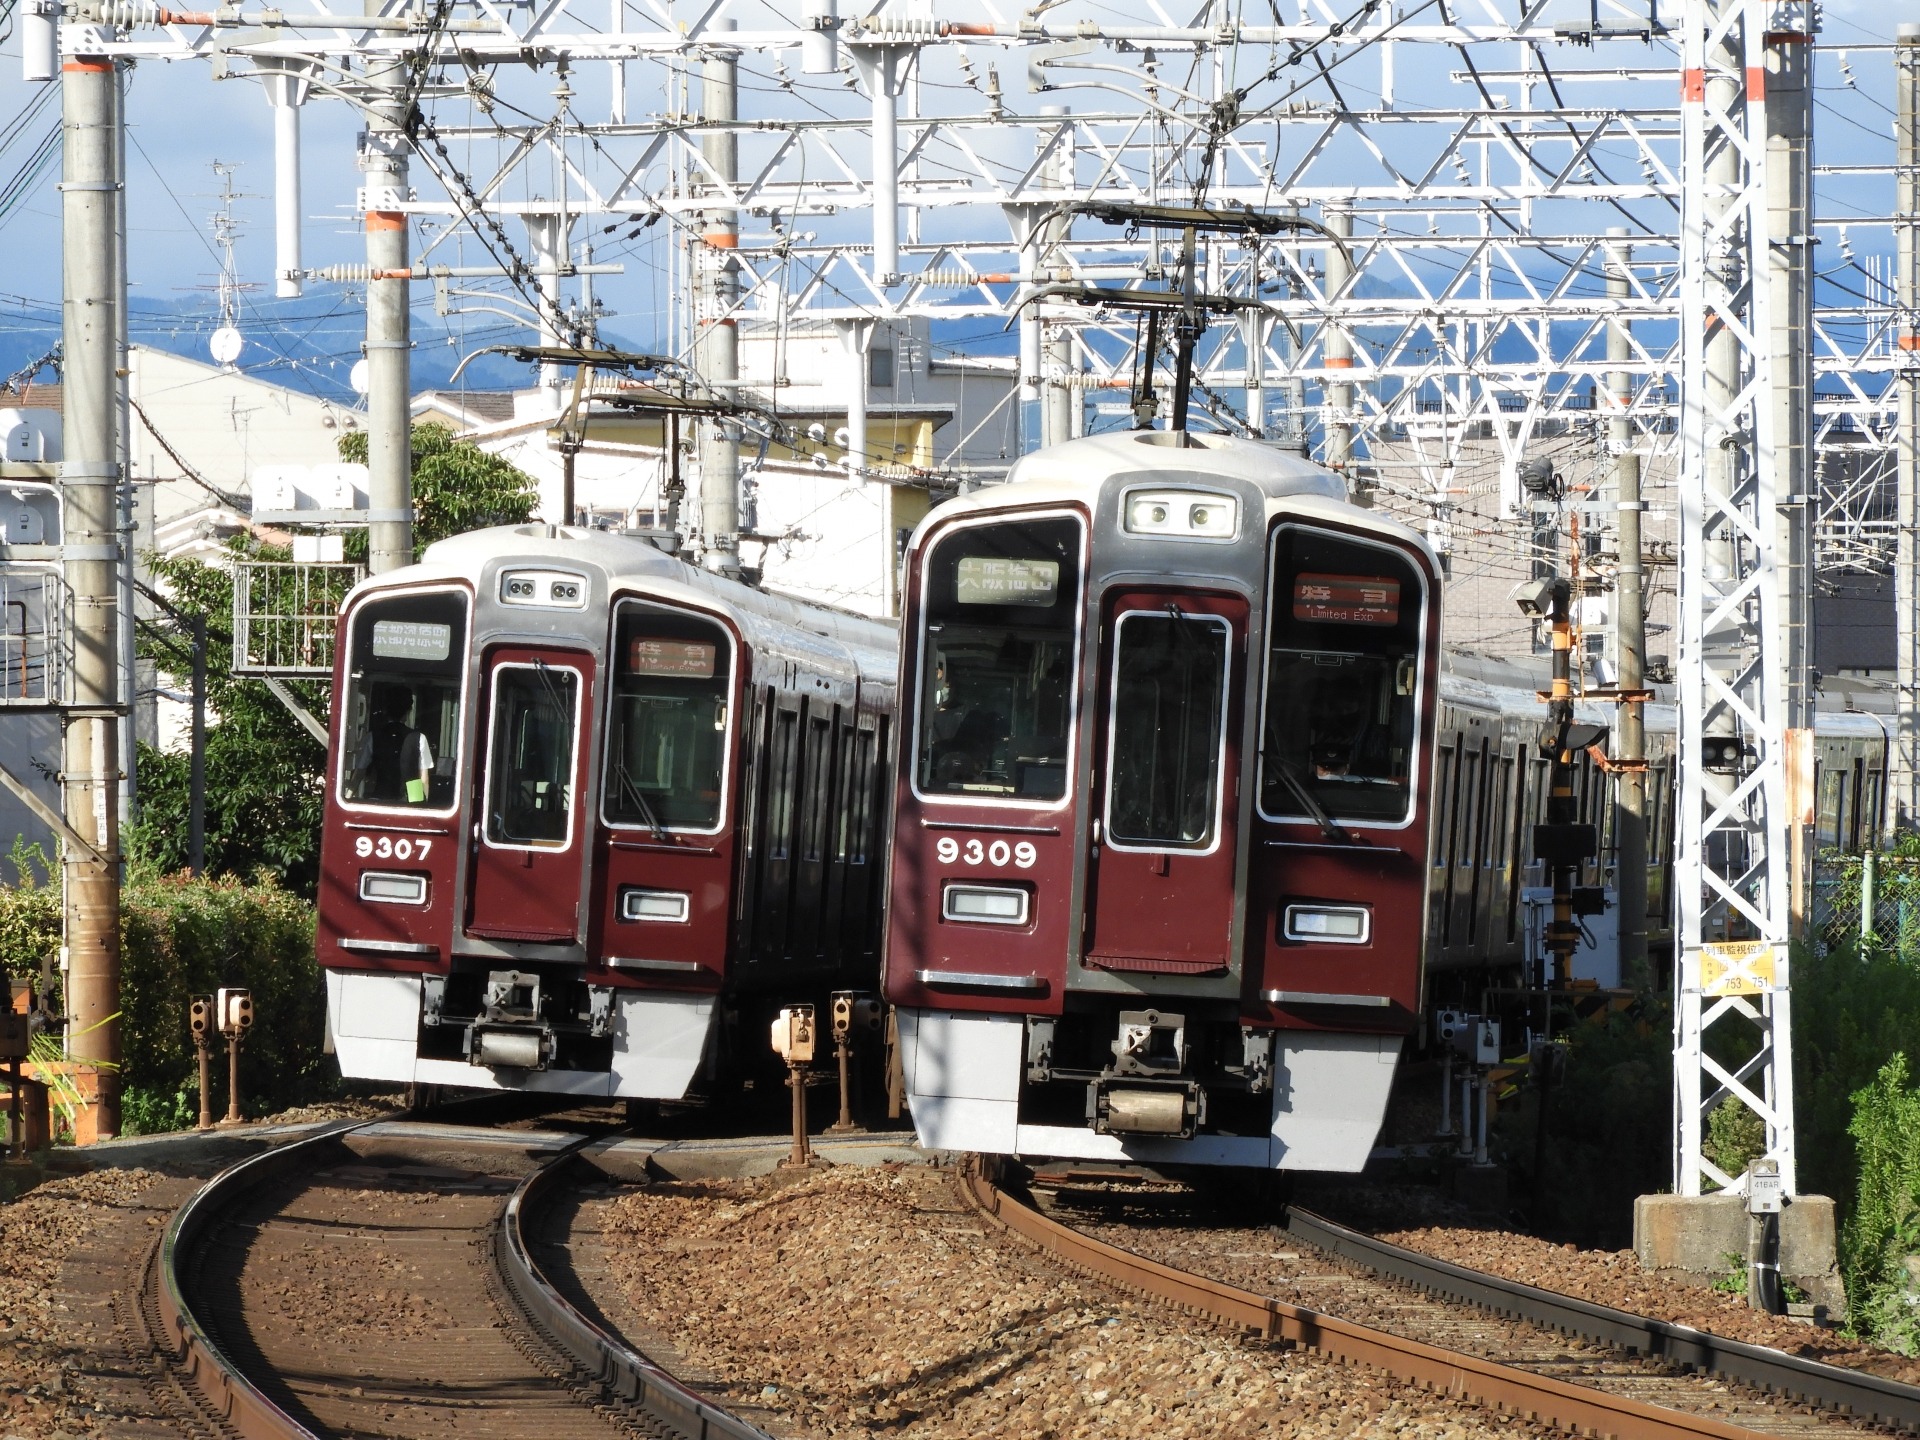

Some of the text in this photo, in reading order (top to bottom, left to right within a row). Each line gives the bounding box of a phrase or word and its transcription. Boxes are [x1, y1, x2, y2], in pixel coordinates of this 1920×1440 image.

[1310, 608, 1347, 620] Limited
[355, 836, 432, 860] 9307
[936, 837, 1037, 868] 9309
[1724, 975, 1768, 989] 753 751
